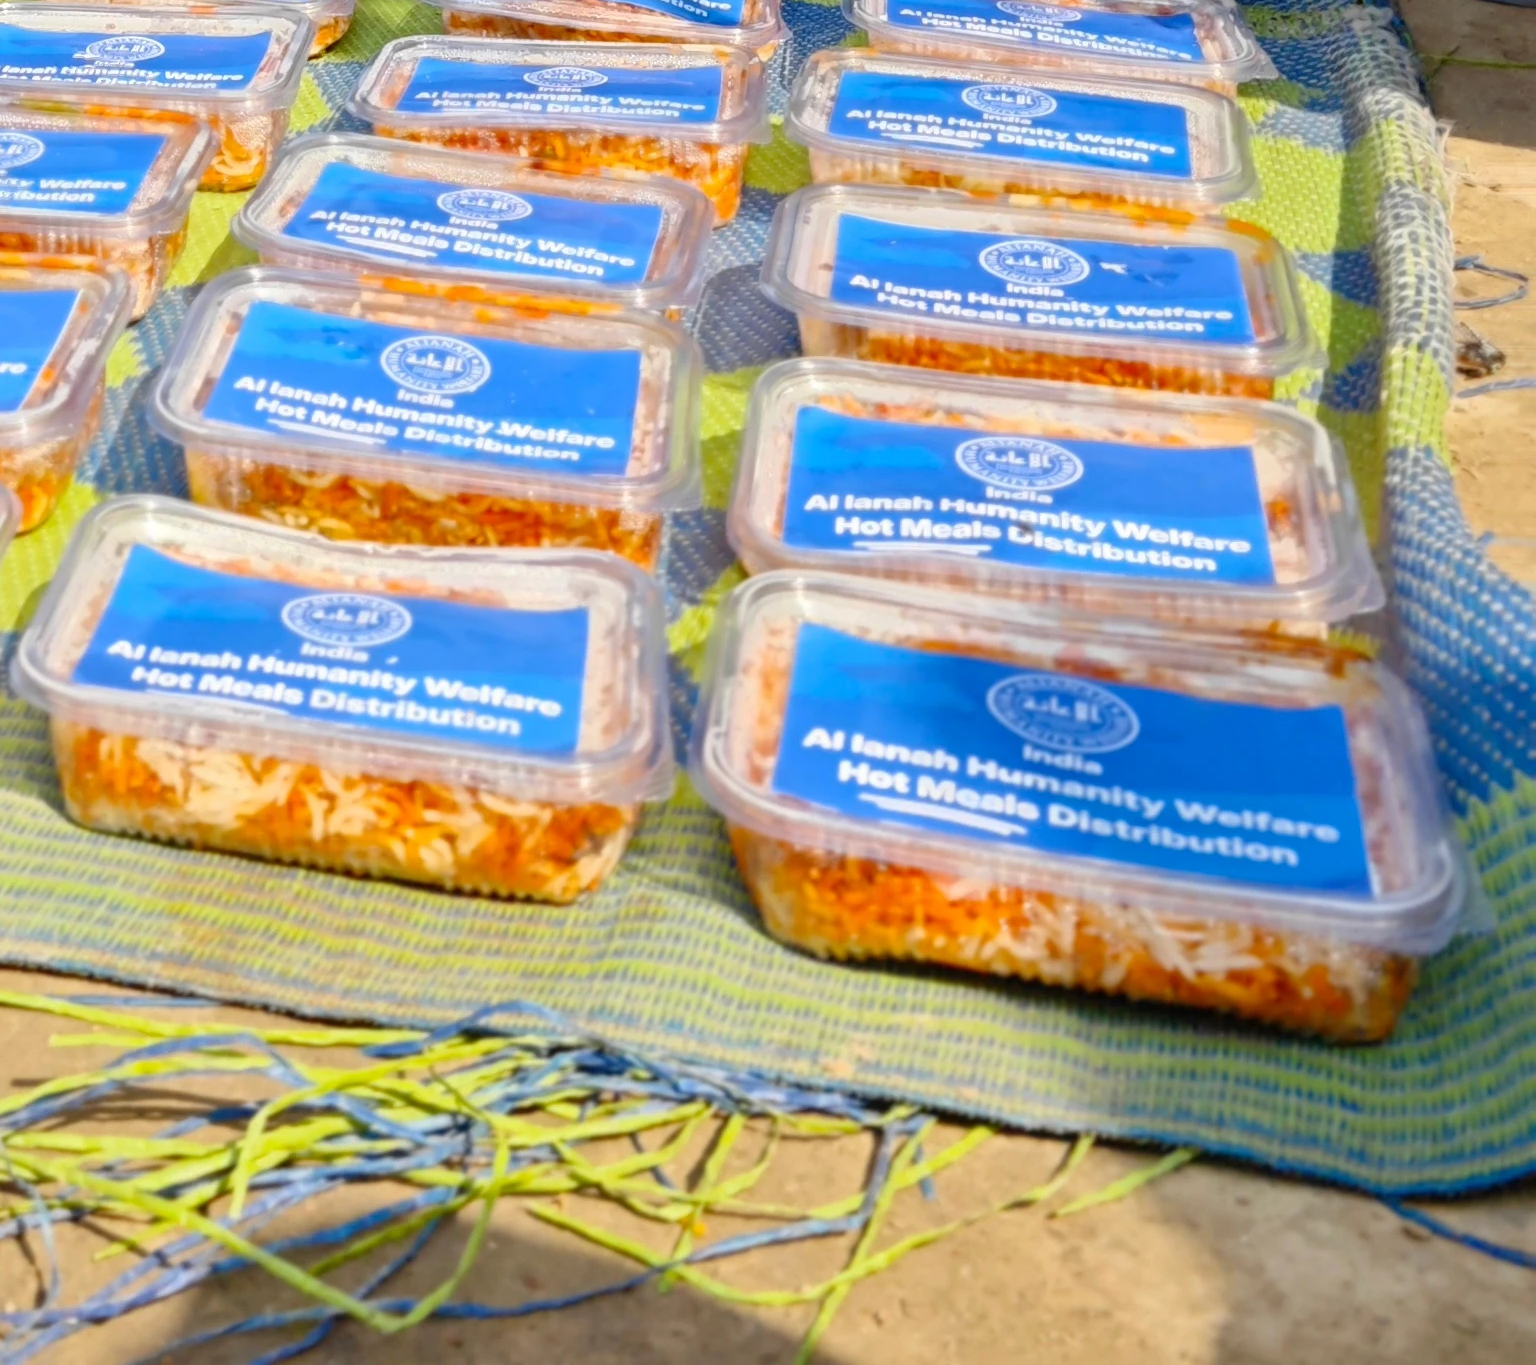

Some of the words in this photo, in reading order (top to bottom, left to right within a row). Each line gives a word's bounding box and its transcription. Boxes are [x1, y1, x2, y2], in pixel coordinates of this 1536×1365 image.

[847, 110, 871, 118] Al
[948, 118, 1068, 141] Humanity
[1076, 133, 1174, 154] Welfare
[869, 121, 912, 135] Hot
[917, 124, 991, 140] Meals
[997, 133, 1148, 162] Distribution
[310, 211, 336, 224] Al
[411, 221, 531, 249] Humanity
[538, 240, 634, 266] Welfare
[450, 215, 500, 229] India
[327, 223, 370, 236] Hot
[375, 228, 448, 248] Meals
[454, 241, 603, 276] Distribution
[848, 273, 881, 290] Al
[968, 292, 1108, 317] Humanity
[1116, 305, 1232, 320] Welfare
[878, 295, 927, 310] Hot
[933, 303, 1020, 324] Meals
[1027, 313, 1203, 332] Distribution
[1007, 282, 1064, 297] India
[235, 378, 267, 392] Al
[352, 398, 493, 437] Humanity
[496, 421, 615, 448] Welfare
[398, 389, 453, 408] India
[256, 398, 307, 420] Hot
[311, 410, 398, 436] Meals
[404, 426, 579, 460] Distribution
[986, 484, 1052, 504] India
[805, 495, 839, 511] Al
[940, 498, 1106, 538] Humanity
[1112, 520, 1250, 553] Welfare
[835, 517, 893, 536] Hot
[900, 519, 1001, 539] Meals
[1008, 526, 1216, 571] Distribution
[301, 641, 368, 662] India
[107, 640, 145, 660] Al
[247, 655, 417, 696] Humanity
[424, 677, 562, 717] Welfare
[132, 667, 193, 690] Hot
[199, 674, 303, 704] Meals
[310, 690, 520, 735] Distribution
[1023, 744, 1102, 775] India
[803, 728, 844, 751] Al
[967, 756, 1163, 817] Humanity
[1175, 800, 1339, 842] Welfare
[838, 760, 909, 794] Hot
[916, 775, 1039, 820] Meals
[1048, 804, 1297, 865] Distribution
